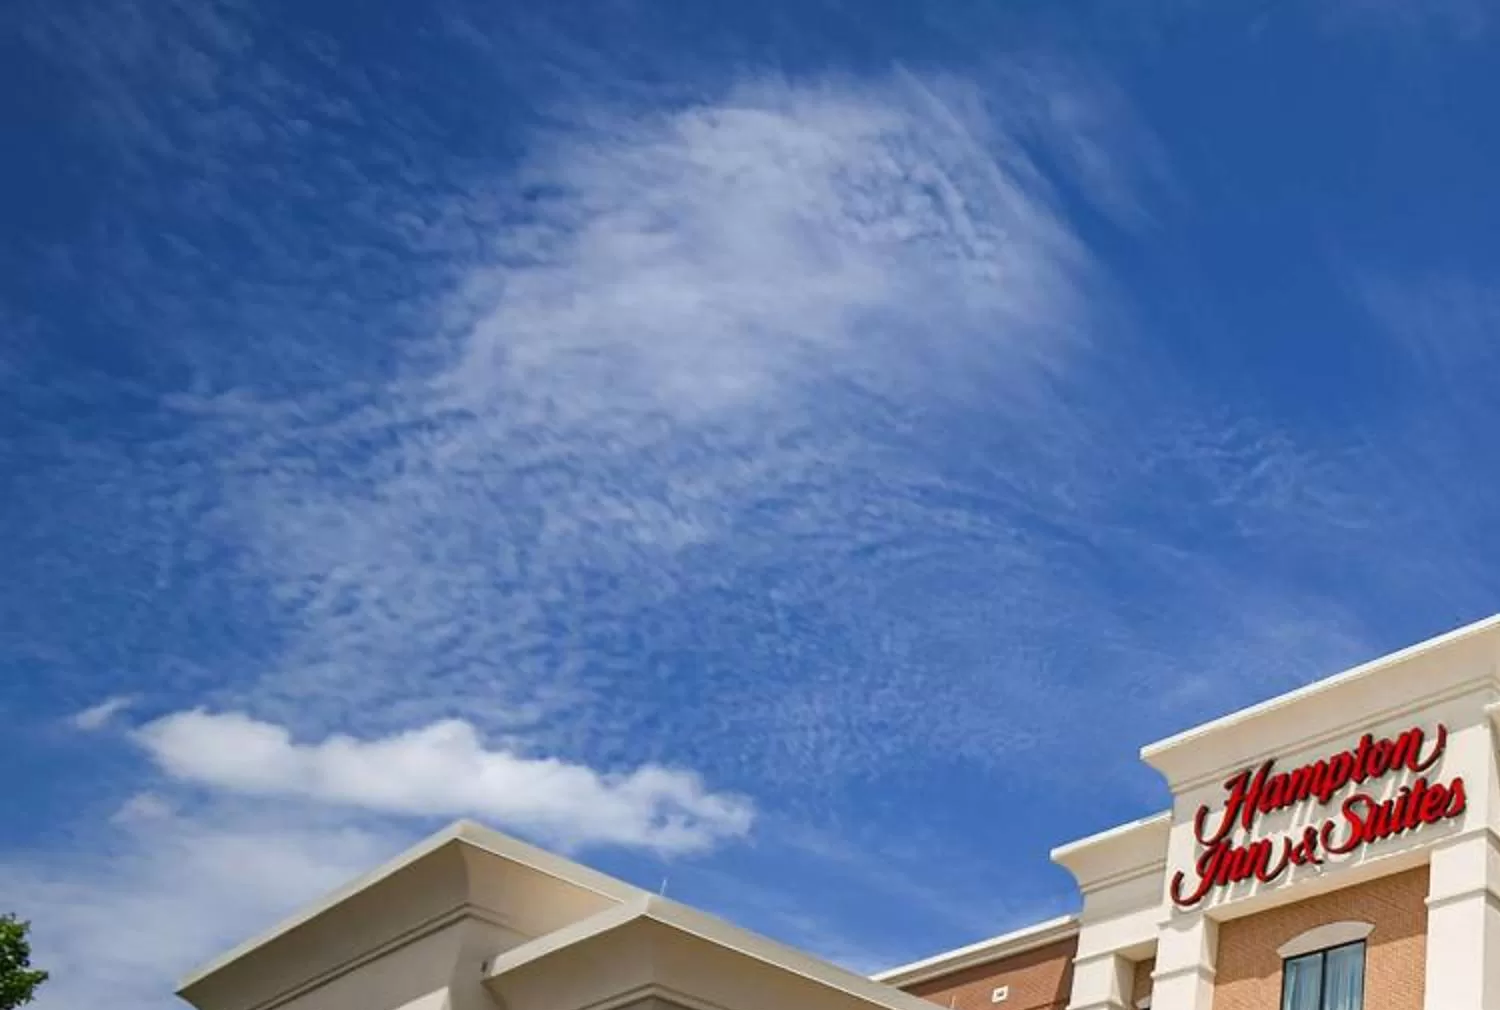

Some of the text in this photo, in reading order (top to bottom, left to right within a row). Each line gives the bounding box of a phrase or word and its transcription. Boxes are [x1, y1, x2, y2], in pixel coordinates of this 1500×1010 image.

[1170, 777, 1467, 906] Inn & Suites
[1194, 723, 1447, 846] Hampton
